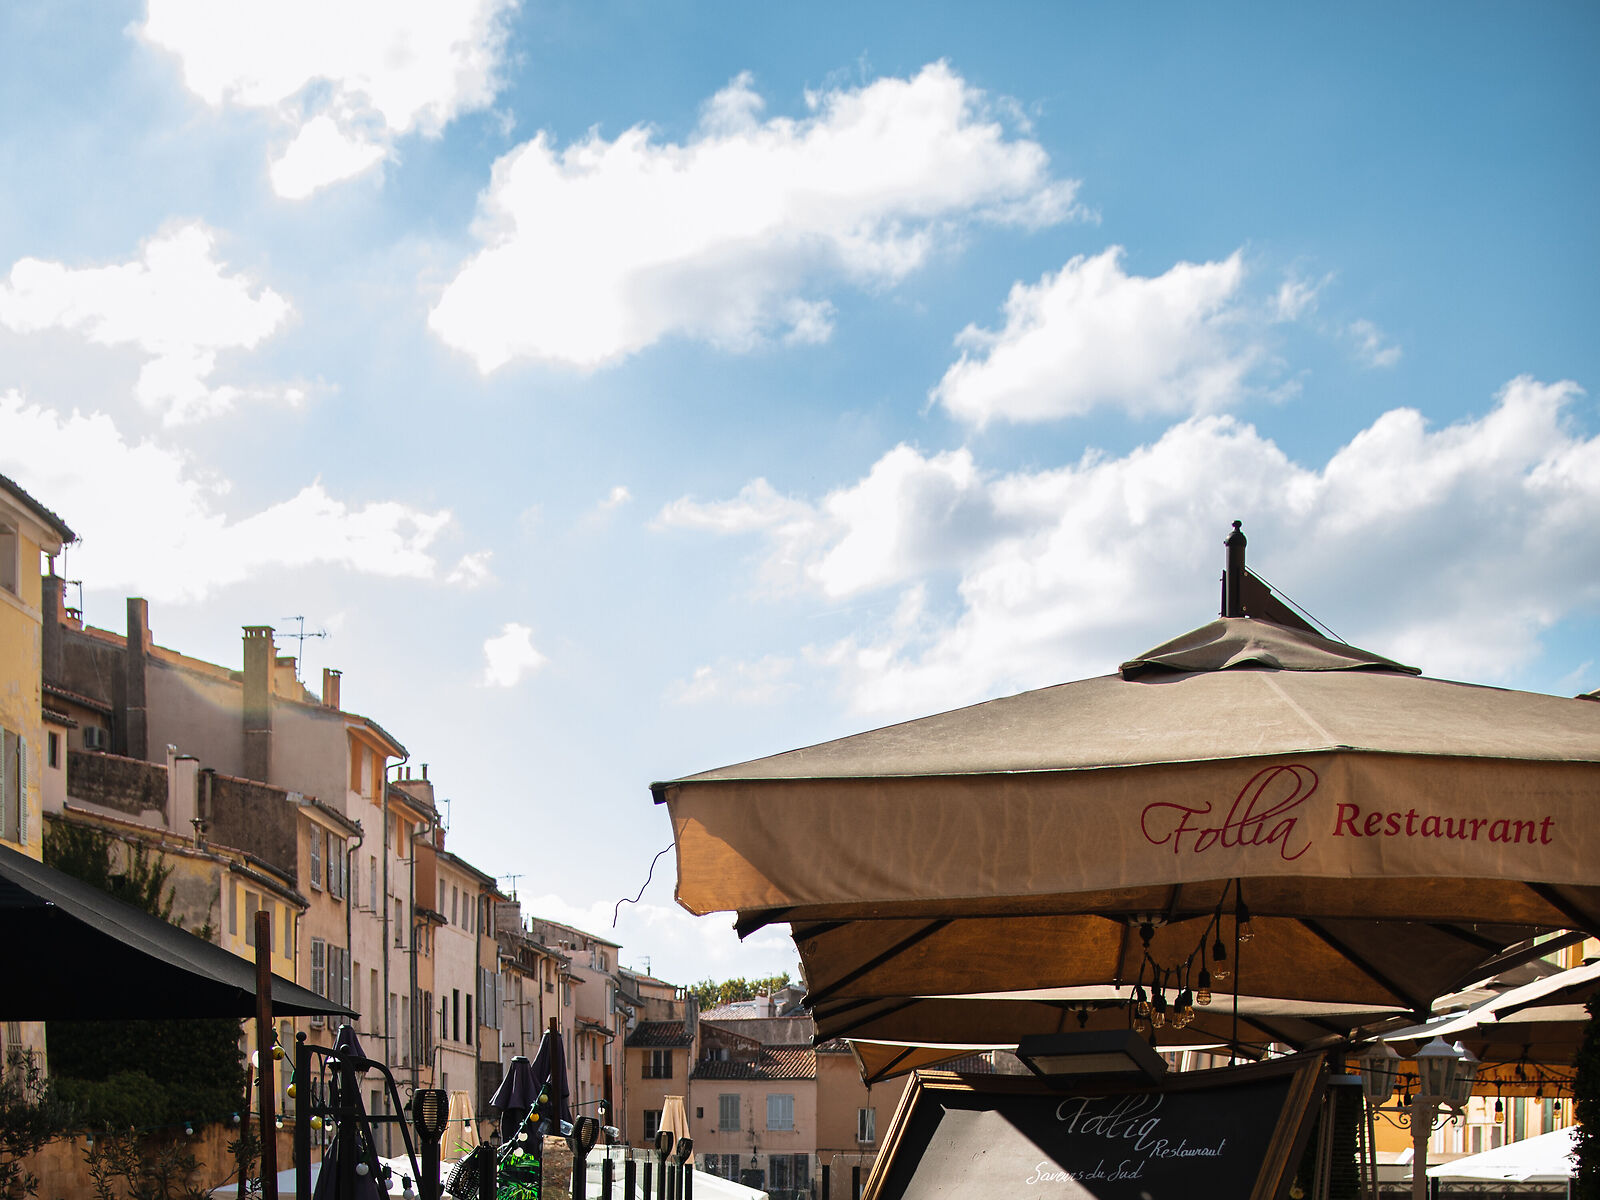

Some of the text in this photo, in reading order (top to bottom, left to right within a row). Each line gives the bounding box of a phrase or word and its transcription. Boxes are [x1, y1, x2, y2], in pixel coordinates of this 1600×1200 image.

[1141, 764, 1555, 861] Follia Restaurant
[1150, 1139, 1226, 1158] Restaurant
[1026, 1160, 1144, 1183] Saveurs du Sud
